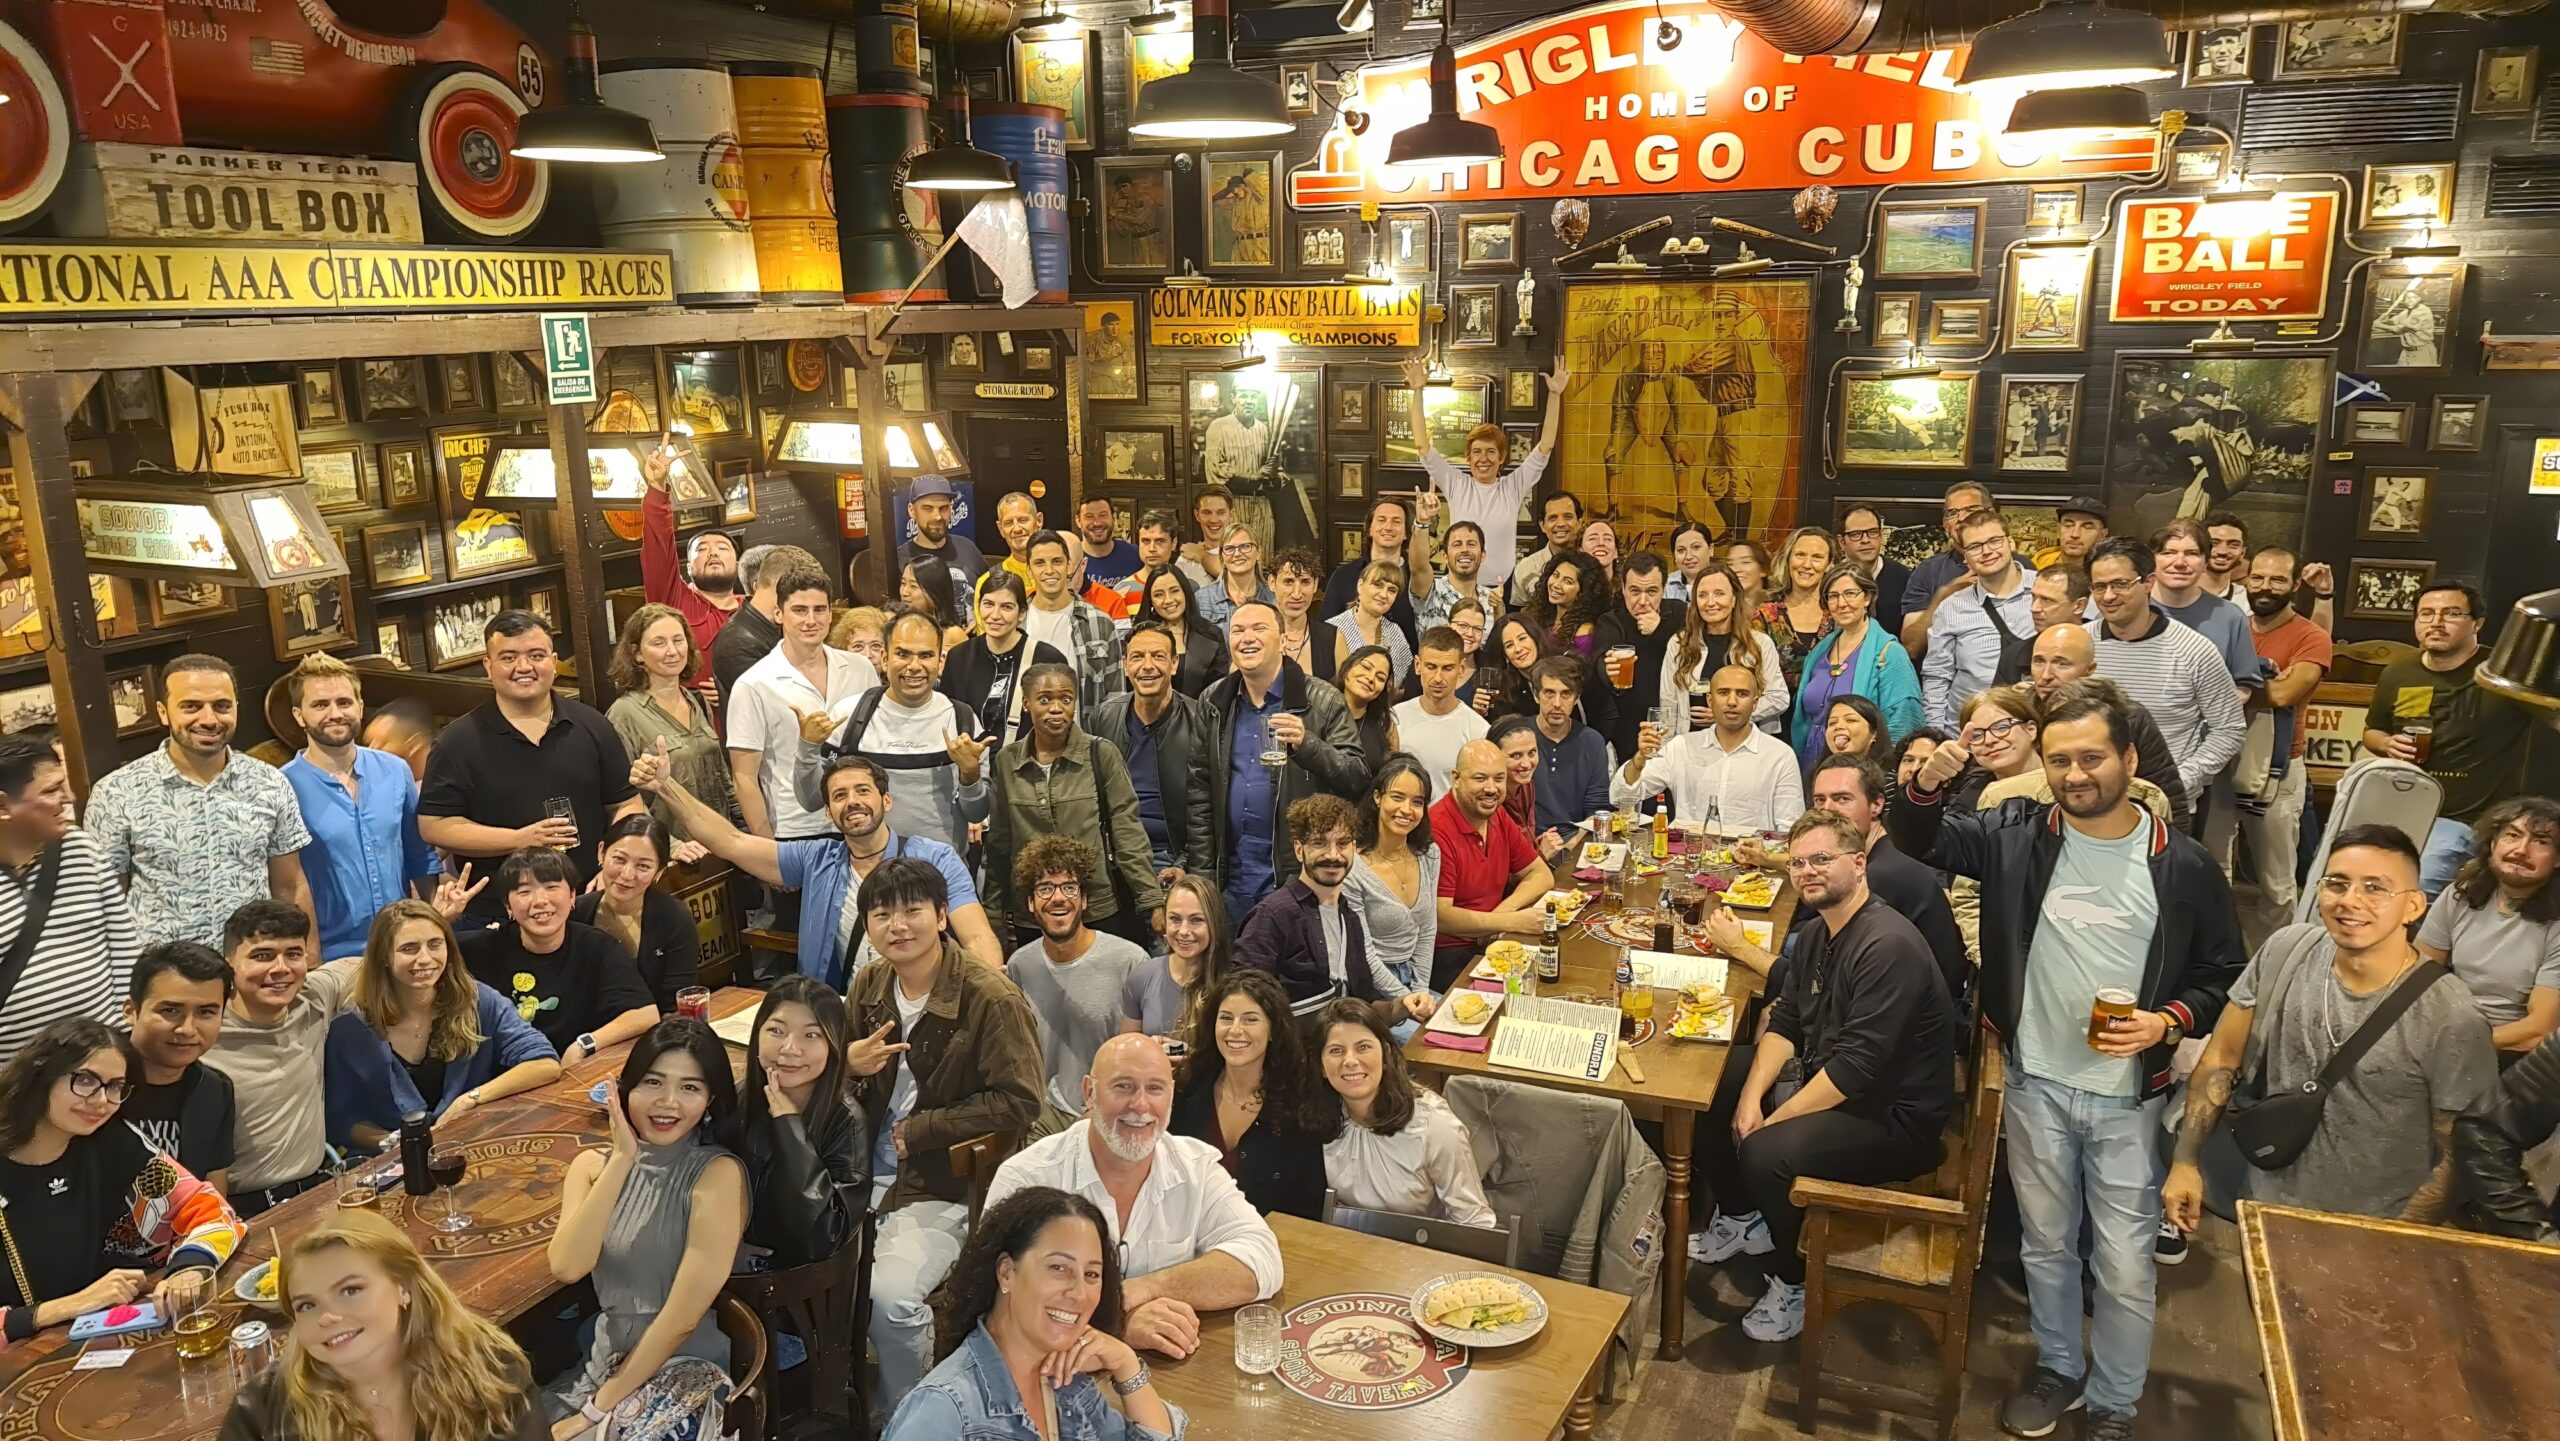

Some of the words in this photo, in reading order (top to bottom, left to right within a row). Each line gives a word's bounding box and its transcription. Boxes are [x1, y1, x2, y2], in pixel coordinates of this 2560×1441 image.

[520, 56, 541, 96] 55
[1585, 91, 1708, 121] HOME
[1743, 84, 1797, 112] OF
[114, 113, 152, 130] USA
[1798, 117, 2042, 177] CUB
[148, 151, 283, 172] PARKER
[297, 160, 380, 177] TEAM
[148, 184, 284, 231] TOOL
[297, 189, 390, 234] BOX
[2143, 238, 2305, 274] BALL
[0, 252, 189, 303] TIONAL
[207, 254, 294, 301] AAA
[308, 256, 566, 300] CHAMPIONSHIP
[2169, 282, 2223, 291] WRIGLEY
[2227, 281, 2263, 290] FIELD
[1253, 289, 1300, 318] BASE
[1306, 289, 1356, 317] BALL
[1366, 288, 1418, 317] BATS
[2143, 297, 2289, 313] TODAY
[1171, 331, 1203, 345] FOR
[1288, 331, 1398, 346] CHAMPIONS
[983, 385, 1019, 396] STORAGE
[1020, 385, 1045, 397] ROOM
[224, 402, 249, 418] FUSE
[251, 402, 271, 413] BOX
[232, 450, 250, 464] AUTO
[1588, 1033, 1607, 1078] SONORA
[1324, 1374, 1437, 1404] TAVERN
